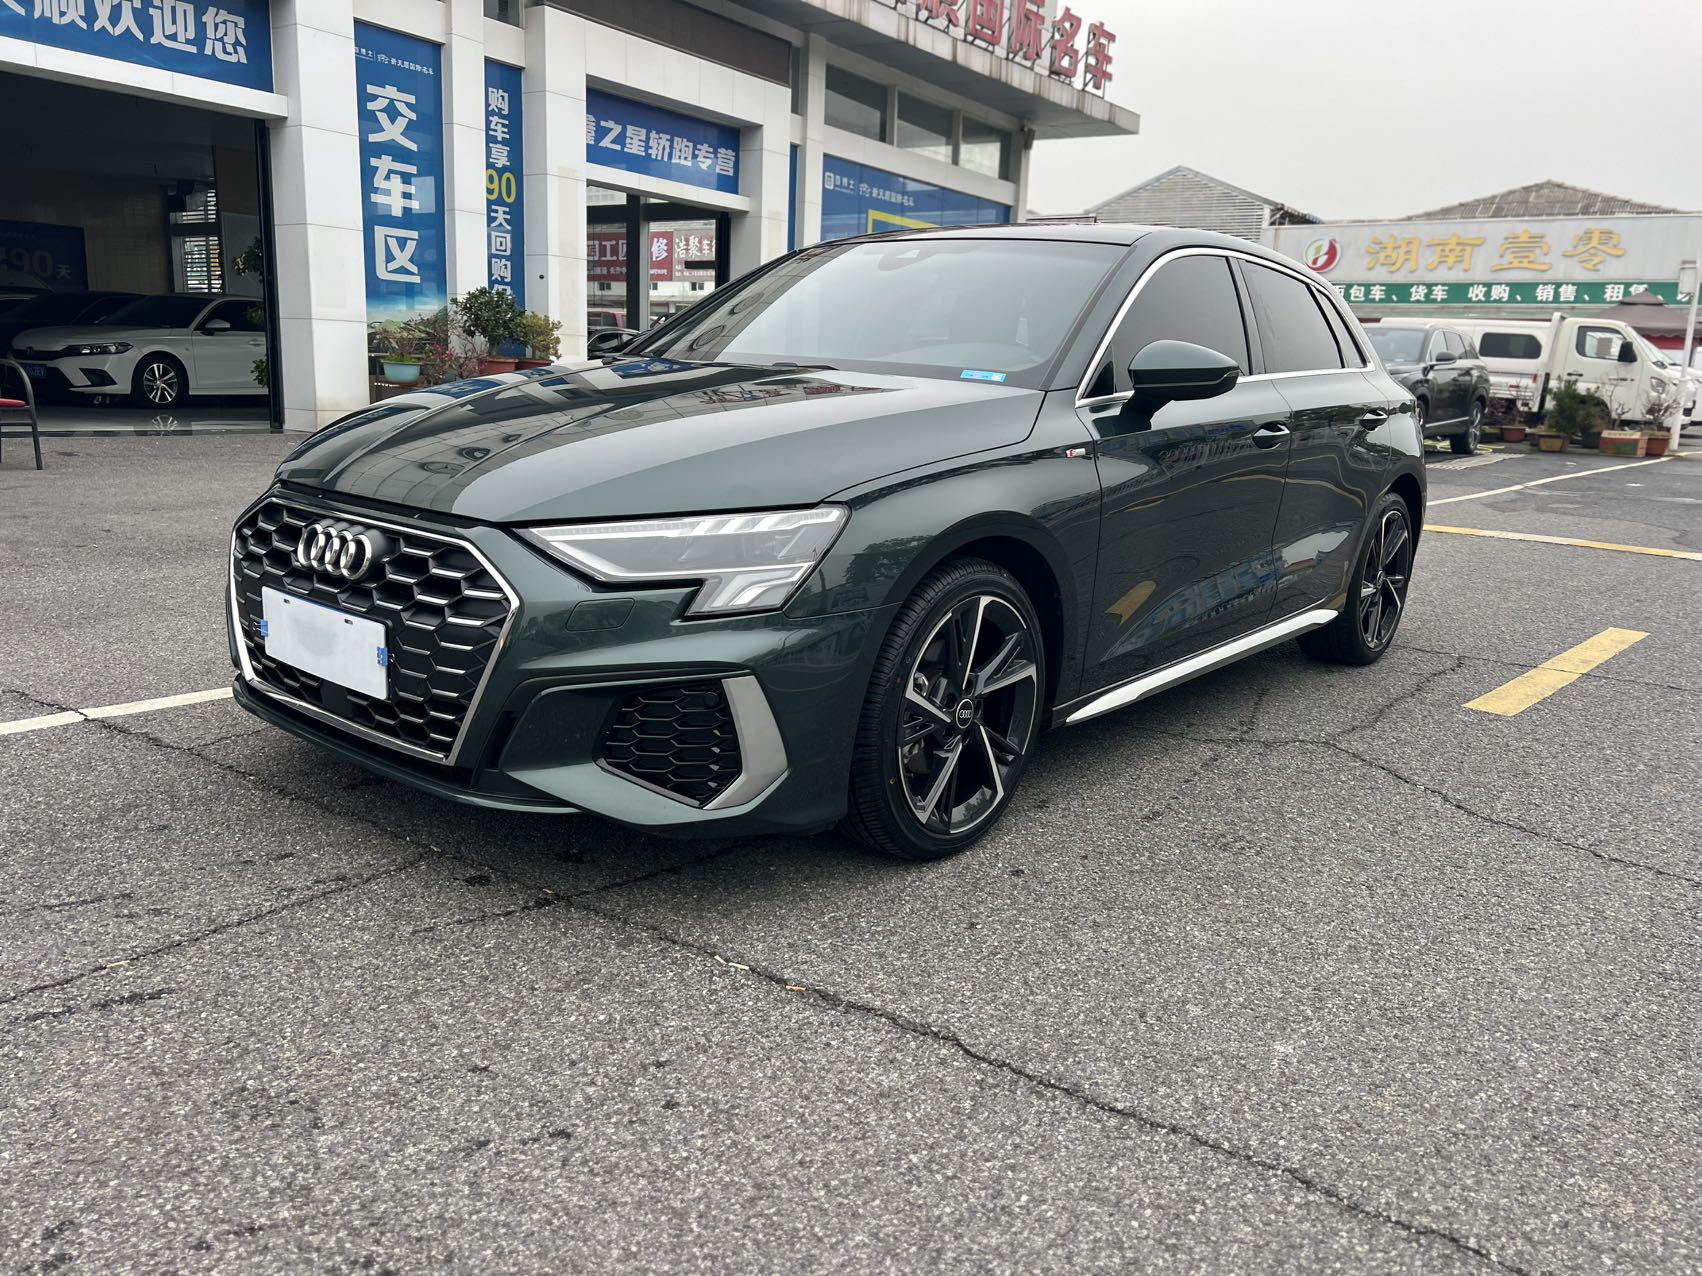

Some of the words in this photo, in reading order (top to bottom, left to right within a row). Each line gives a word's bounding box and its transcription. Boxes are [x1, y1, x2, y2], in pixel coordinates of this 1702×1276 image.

[0, 0, 248, 64] 顺欢迎您
[366, 84, 421, 284] 交车区
[652, 238, 668, 261] 修
[1364, 228, 1627, 273] 湖南壹零
